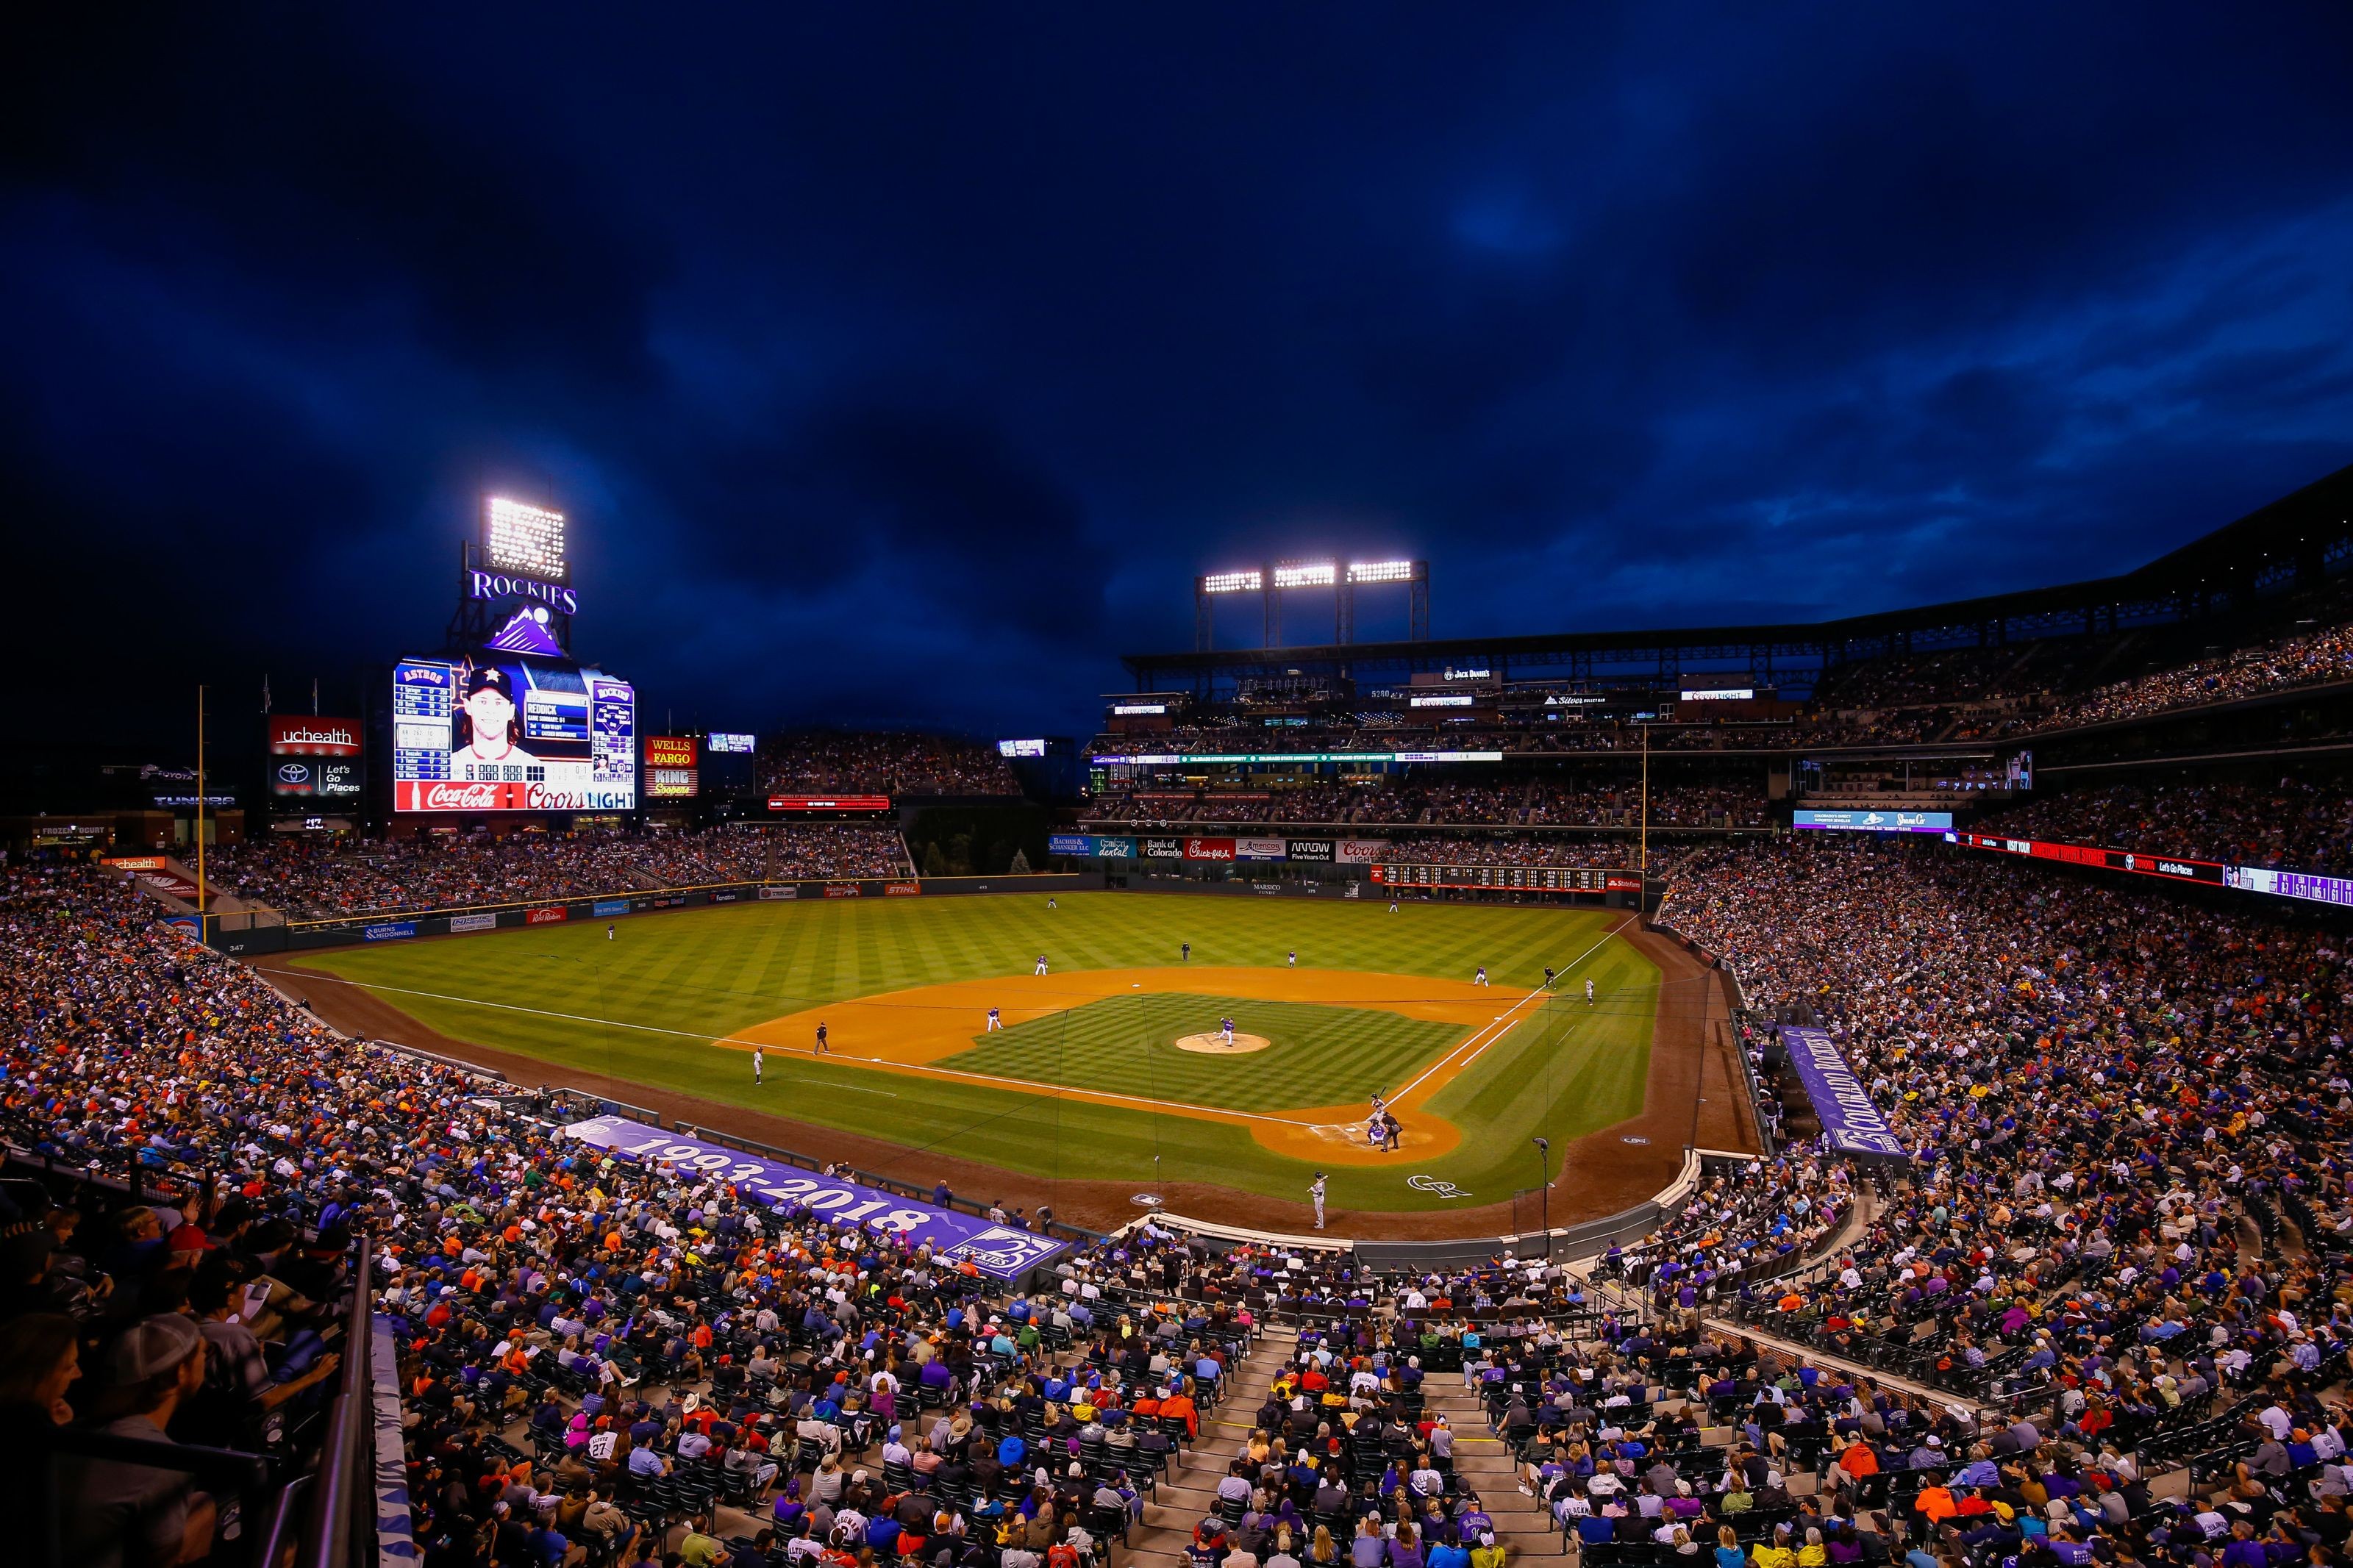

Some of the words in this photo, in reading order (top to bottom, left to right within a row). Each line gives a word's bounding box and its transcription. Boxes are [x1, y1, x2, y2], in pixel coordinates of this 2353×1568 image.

[469, 570, 577, 616] ROCKIES
[404, 669, 443, 684] ASTROS
[1469, 670, 1490, 678] DANIEL'S
[597, 687, 630, 701] ROCKIES
[1558, 696, 1583, 705] Silver
[1692, 691, 1718, 700] Coors
[1419, 698, 1443, 706] Coors
[528, 704, 557, 715] REDDICK
[283, 726, 351, 744] uchealth
[652, 740, 690, 751] WELLS
[653, 753, 690, 764] FARGO
[326, 765, 350, 773] Let's
[655, 770, 689, 783] KING
[276, 784, 313, 792] TOYOTA
[326, 784, 360, 792] Places
[654, 783, 690, 795] Soopers
[427, 784, 499, 809] Coca-Cola
[527, 783, 585, 809] Coors
[588, 792, 634, 809] LIGHT
[1896, 813, 1915, 826] Shane
[1147, 840, 1165, 848] Bank
[1168, 840, 1176, 848] of
[1291, 842, 1330, 853] ARROW
[1343, 841, 1381, 856] Coors
[1099, 845, 1129, 857] dental
[1147, 848, 1182, 857] Colorado
[1189, 843, 1230, 859] Chick-fil-A
[2007, 840, 2018, 852] VISIT
[2018, 841, 2030, 854] YOUR
[2032, 843, 2060, 859] HOMETOWN
[2060, 847, 2080, 861] TOYOTA
[2081, 849, 2107, 865] STORES
[1350, 856, 1374, 864] LIGHT
[2135, 859, 2155, 870] TOYOTA
[2159, 862, 2170, 873] Let's
[2170, 863, 2177, 873] Go
[2177, 864, 2193, 876] Places
[2271, 872, 2276, 881] 55
[2346, 881, 2352, 889] HR
[2241, 878, 2253, 889] GRAY
[2295, 885, 2307, 896] 5.21
[2312, 887, 2326, 900] 105.1
[2332, 889, 2338, 901] 61
[2345, 891, 2352, 903] 11
[532, 914, 543, 923] Red
[543, 912, 561, 921] Robin
[1804, 1038, 1849, 1073] ROCKIES
[1823, 1073, 1888, 1132] COLORADO
[623, 1137, 931, 1233] 1993-2018
[1407, 1175, 1473, 1199] CR
[952, 1246, 1010, 1266] ROCKIES
[994, 1240, 1040, 1268] 25
[593, 1443, 607, 1457] 27
[1415, 1472, 1434, 1484] HELTO
